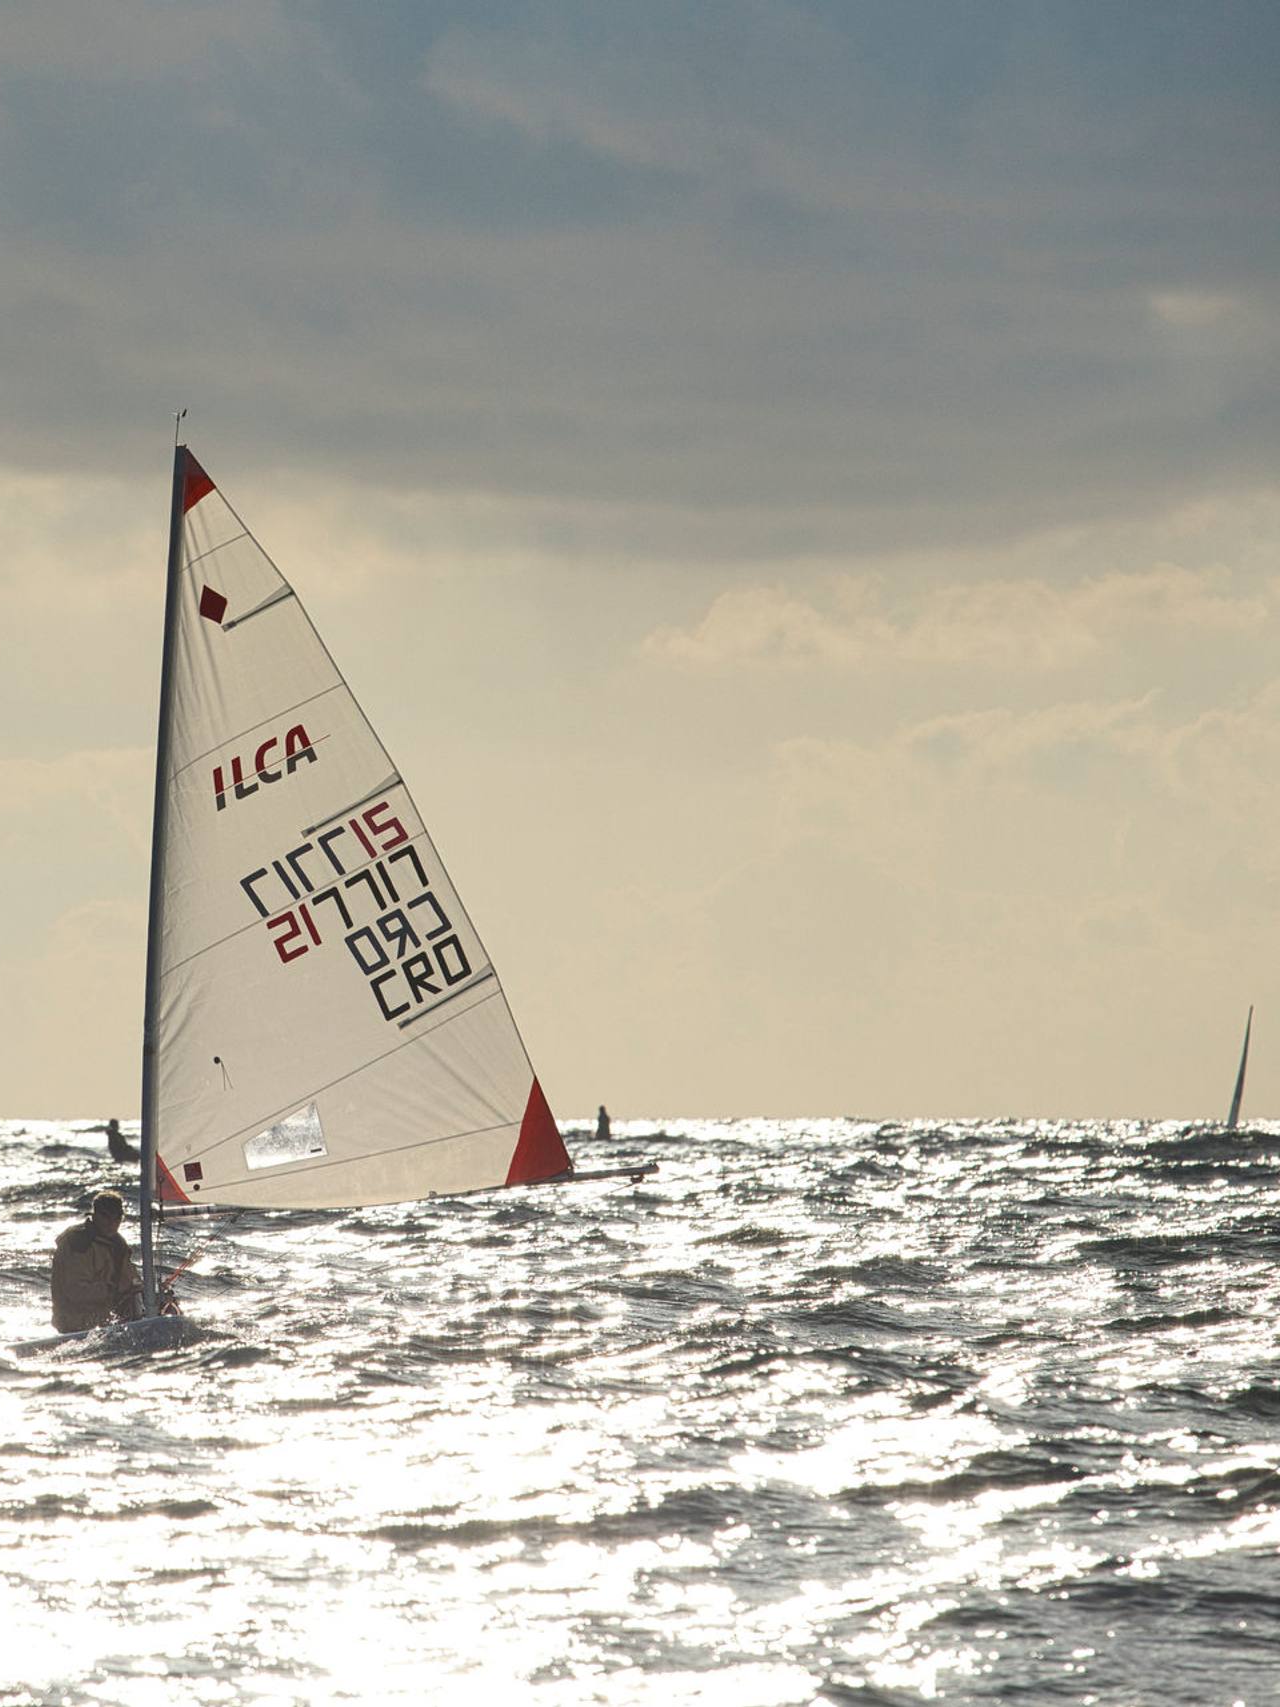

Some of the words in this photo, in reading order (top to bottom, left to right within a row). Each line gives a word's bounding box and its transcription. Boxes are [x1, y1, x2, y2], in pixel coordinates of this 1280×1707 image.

[212, 724, 318, 812] ILCA
[266, 844, 429, 964] 217717
[370, 934, 472, 1021] CRO
